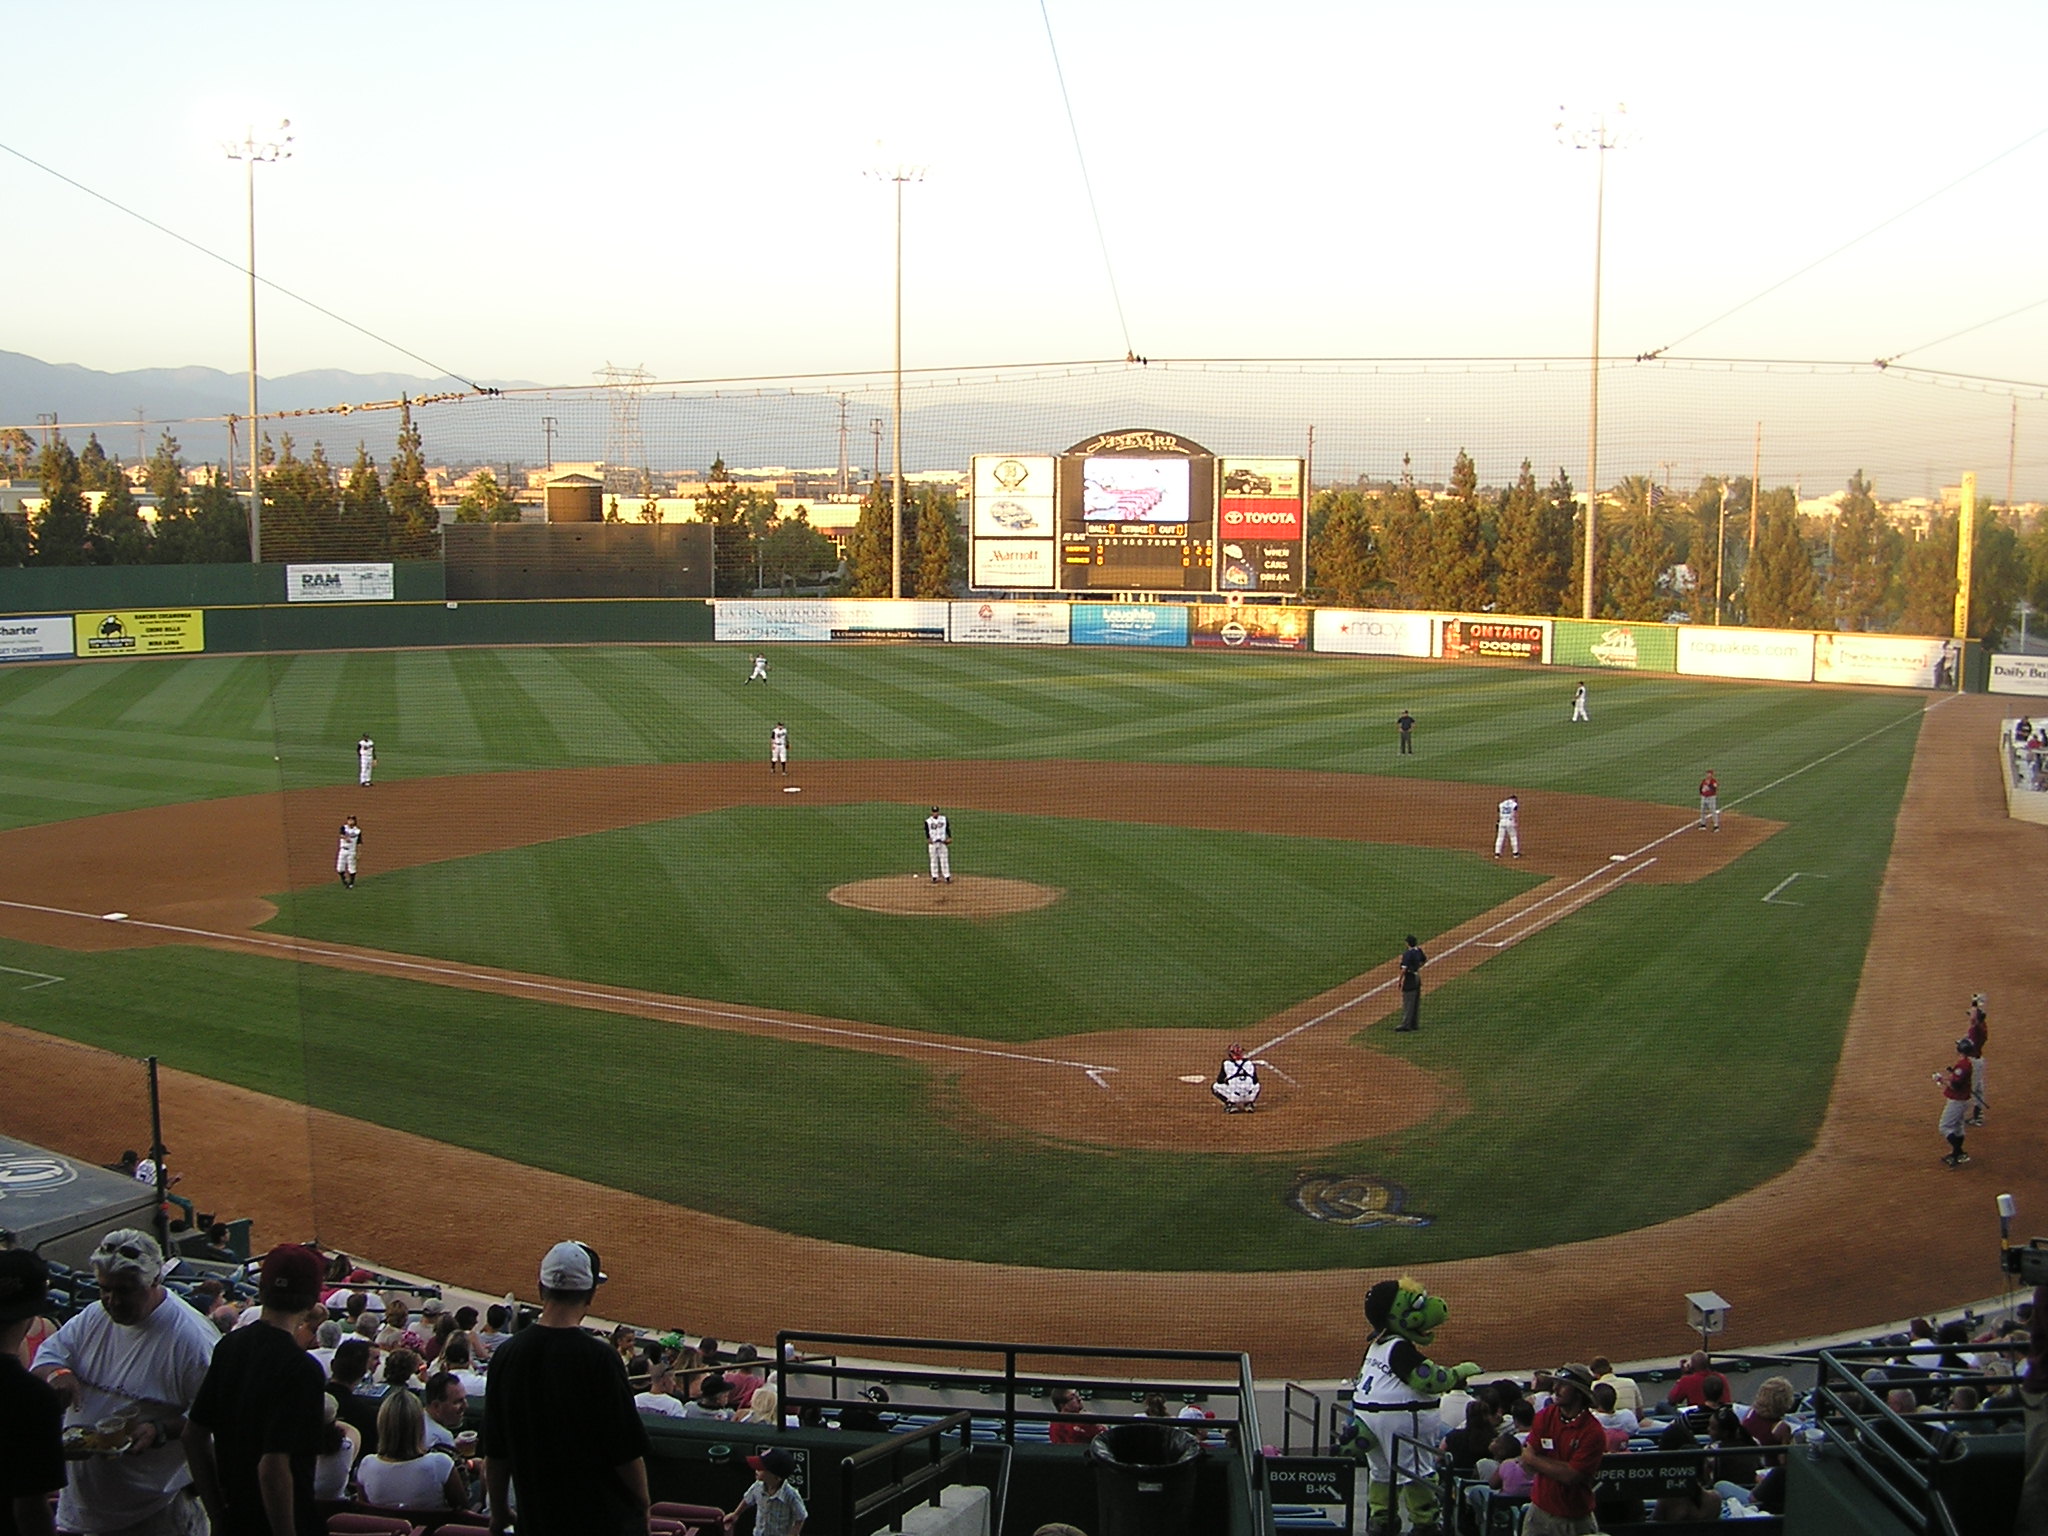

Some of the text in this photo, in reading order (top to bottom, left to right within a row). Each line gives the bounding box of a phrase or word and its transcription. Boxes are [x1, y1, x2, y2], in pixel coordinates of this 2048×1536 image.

[1243, 511, 1297, 524] TOYOTA
[1088, 525, 1108, 533] BALL
[1159, 525, 1175, 534] OUT
[991, 551, 1039, 561] Marriott
[1470, 625, 1541, 640] ONTARIO
[1479, 641, 1531, 651] DODGE
[1994, 666, 2024, 678] Daily
[1270, 1471, 1337, 1482] BOX ROWS
[1593, 1466, 1696, 1480] UPER BOX ROWS
[1306, 1484, 1328, 1494] B-K
